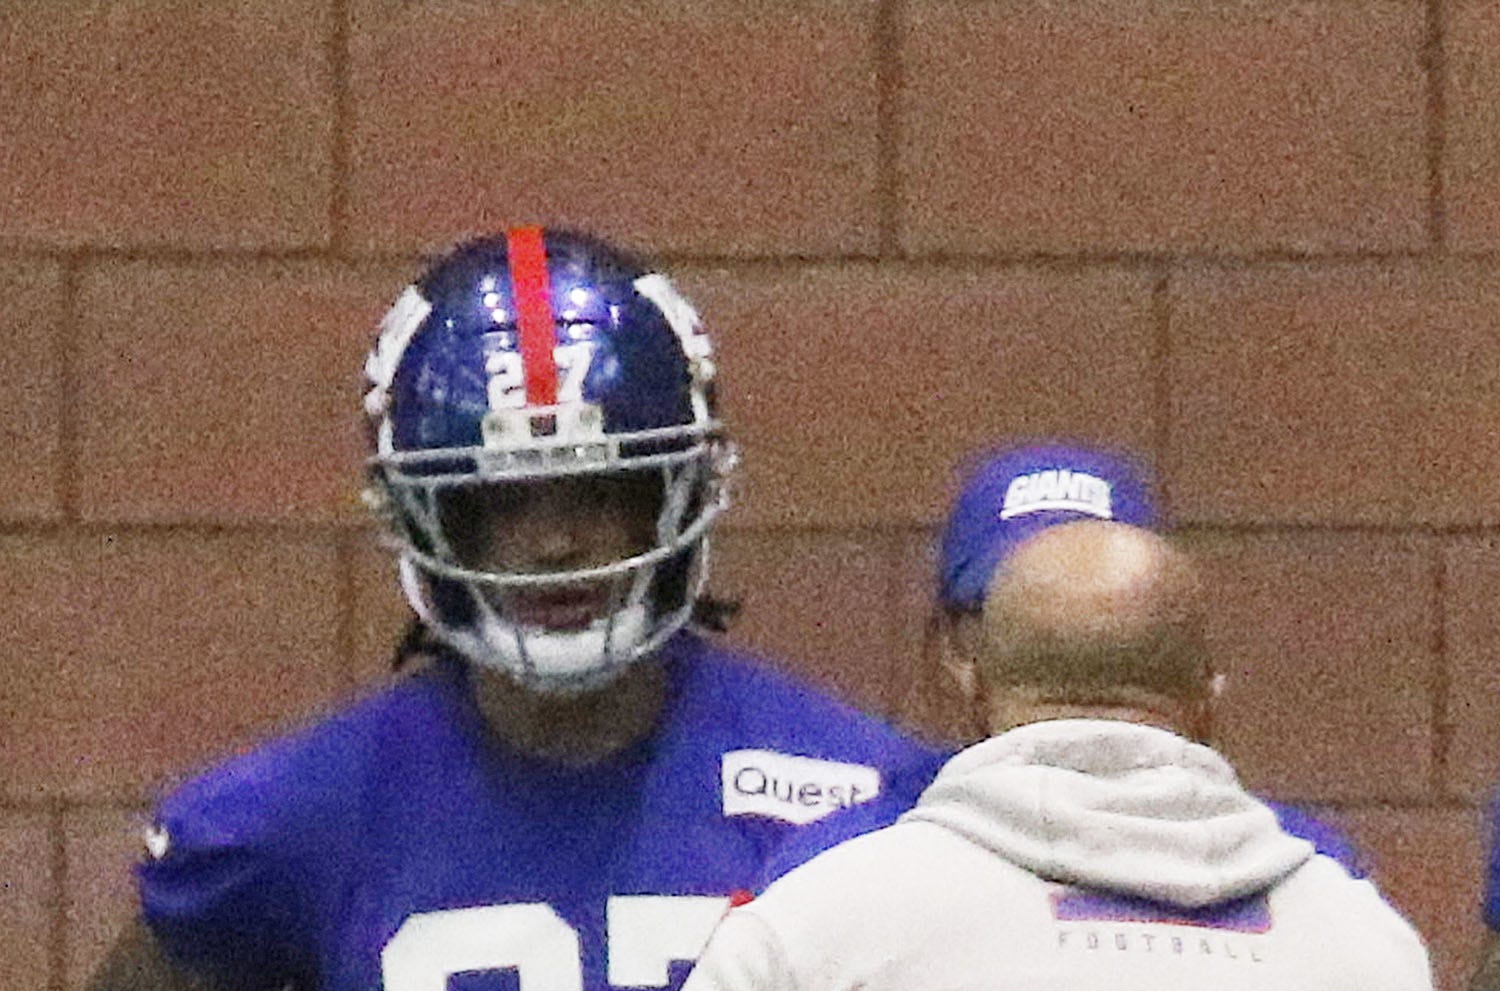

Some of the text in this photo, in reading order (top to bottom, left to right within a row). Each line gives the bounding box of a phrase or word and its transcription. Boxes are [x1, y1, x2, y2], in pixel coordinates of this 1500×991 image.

[484, 340, 597, 410] 27
[735, 757, 862, 806] Quest
[1057, 931, 1262, 963] FOOTBALL
